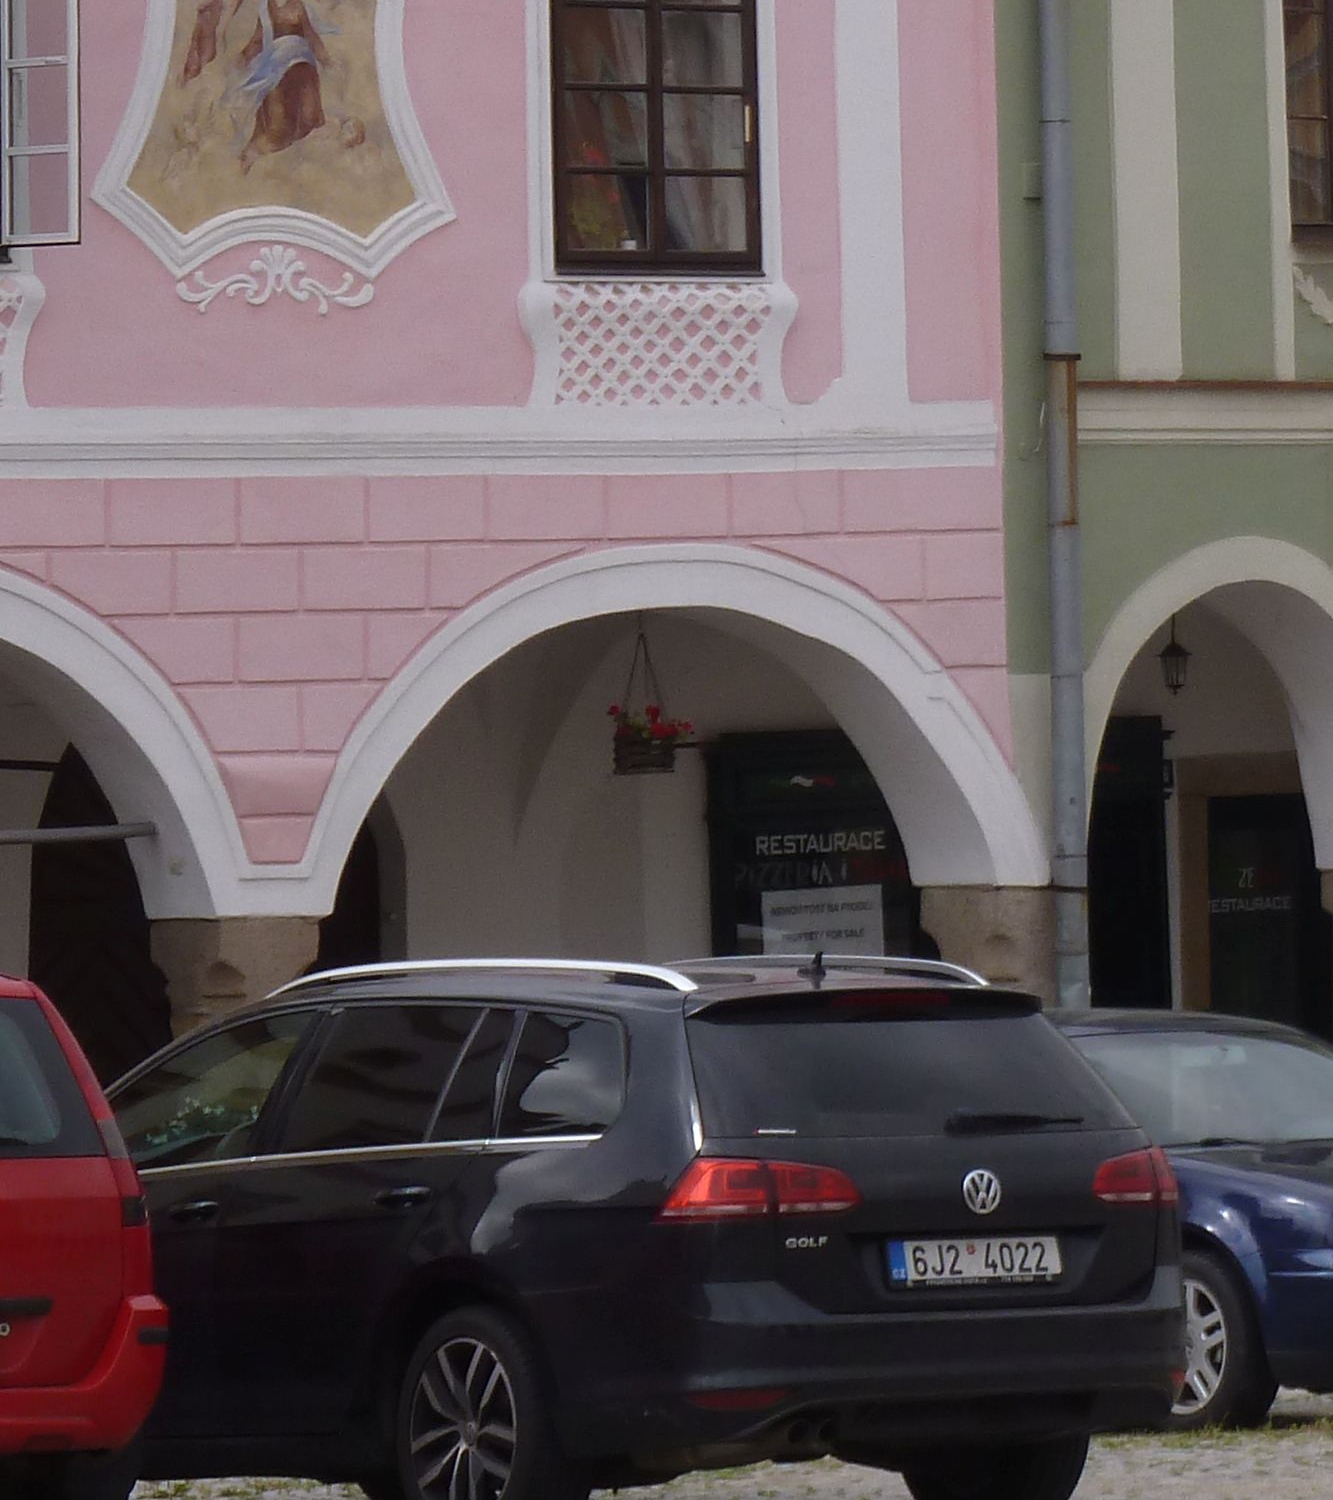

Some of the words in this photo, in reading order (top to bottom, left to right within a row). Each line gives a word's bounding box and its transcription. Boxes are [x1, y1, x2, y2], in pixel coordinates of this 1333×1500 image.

[755, 830, 887, 856] RESTAURACE
[785, 1236, 829, 1249] GOLF
[912, 1243, 963, 1276] 6J2
[984, 1242, 1048, 1273] 4022
